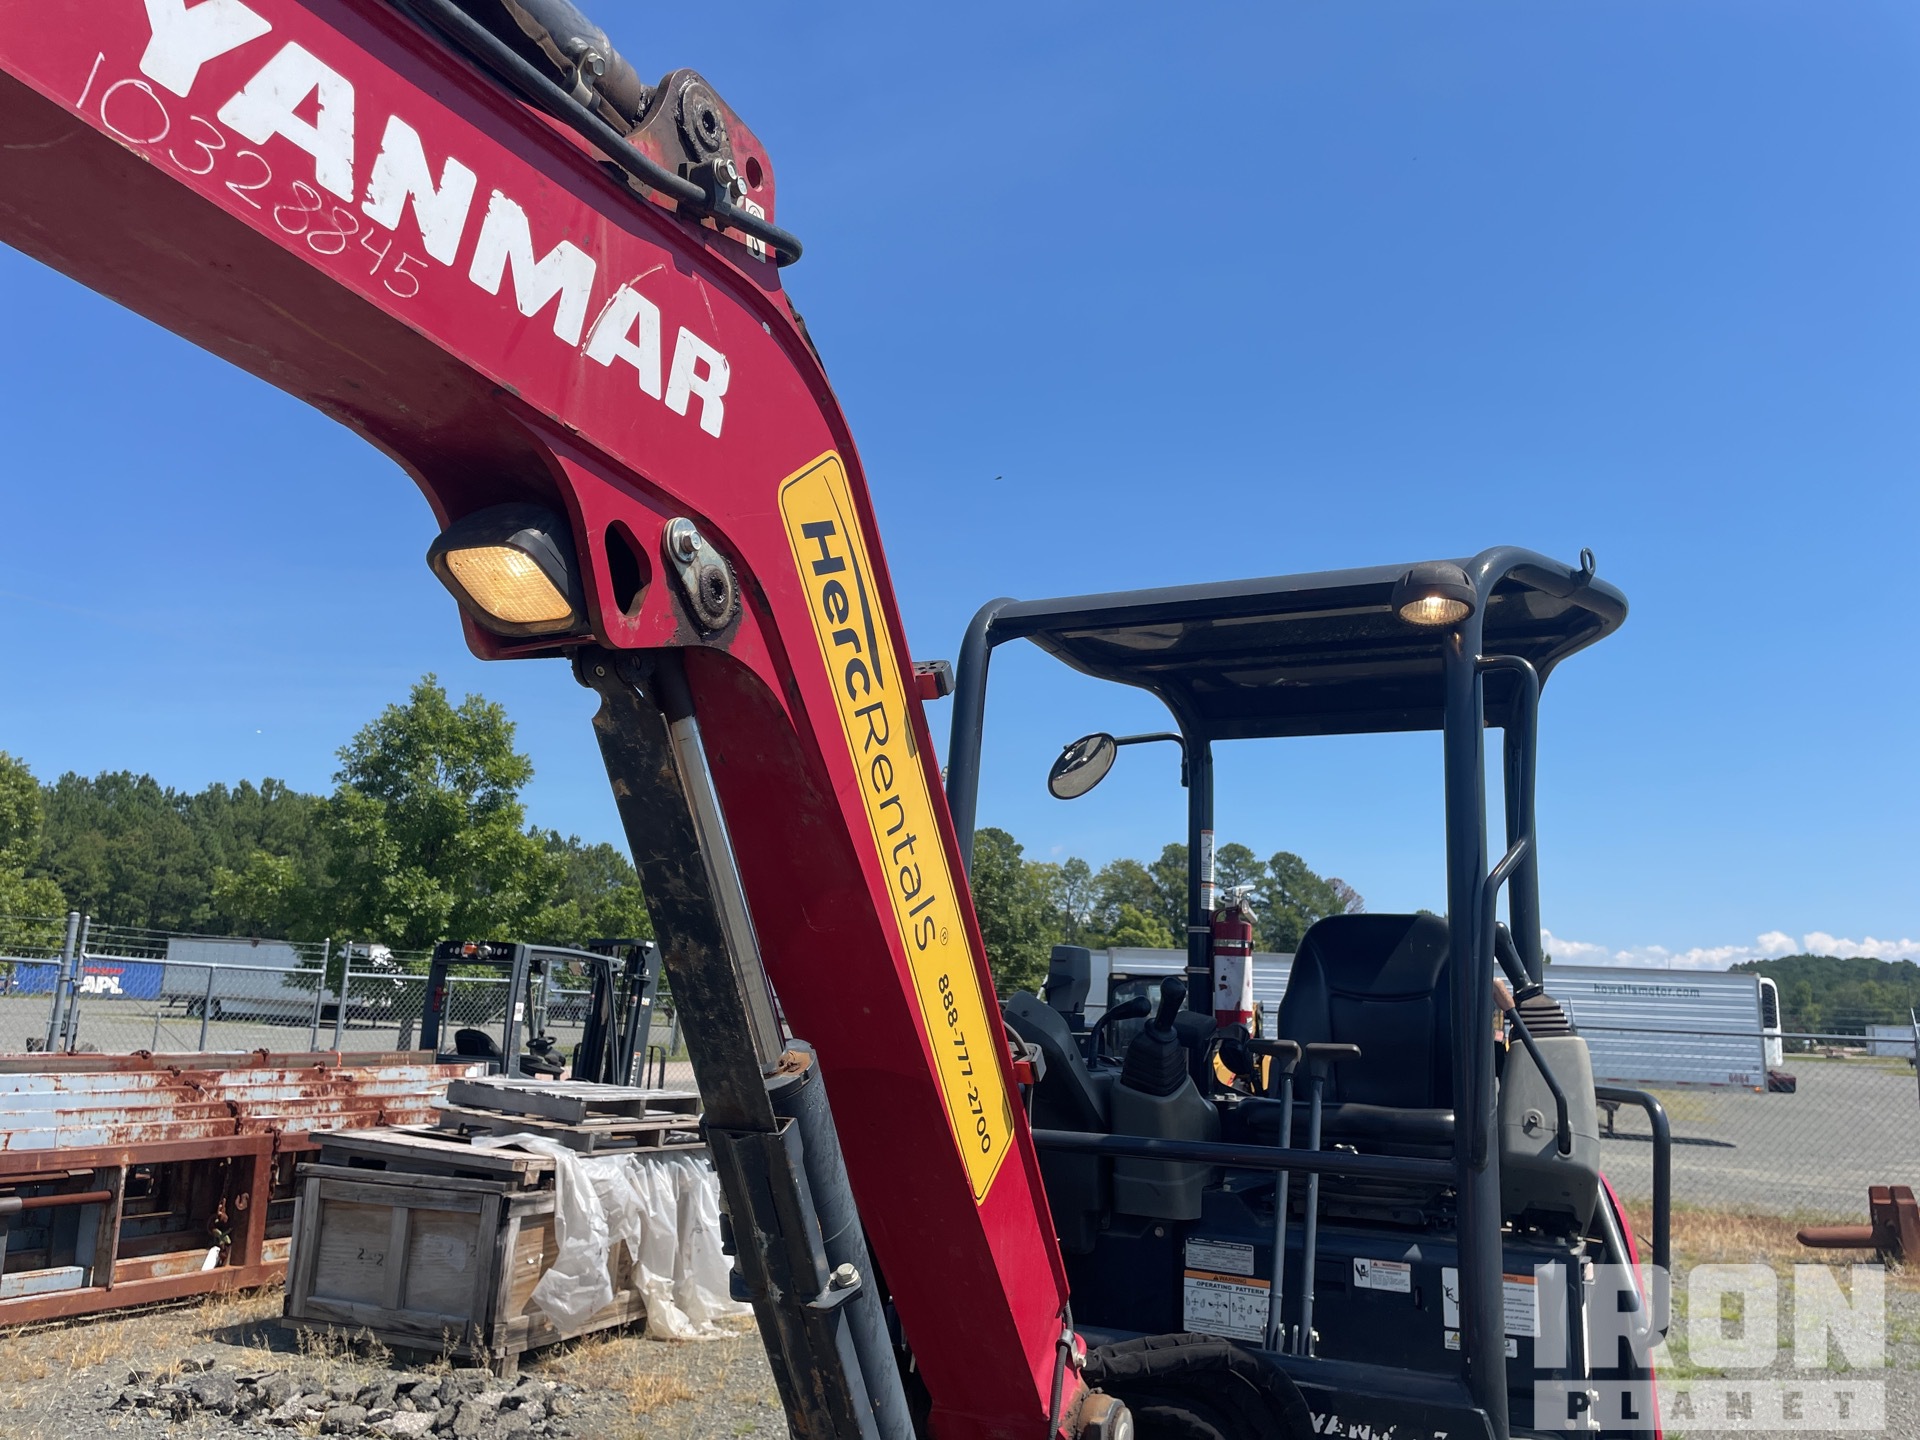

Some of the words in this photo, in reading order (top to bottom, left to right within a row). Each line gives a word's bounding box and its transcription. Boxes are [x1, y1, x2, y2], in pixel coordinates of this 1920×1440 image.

[75, 51, 429, 298] 10328845
[139, 0, 730, 438] YANMAR
[80, 975, 123, 995] APL
[938, 973, 991, 1154] 888-777-2700
[1196, 1281, 1233, 1291] OPERATING
[1235, 1286, 1265, 1295] PATTERN
